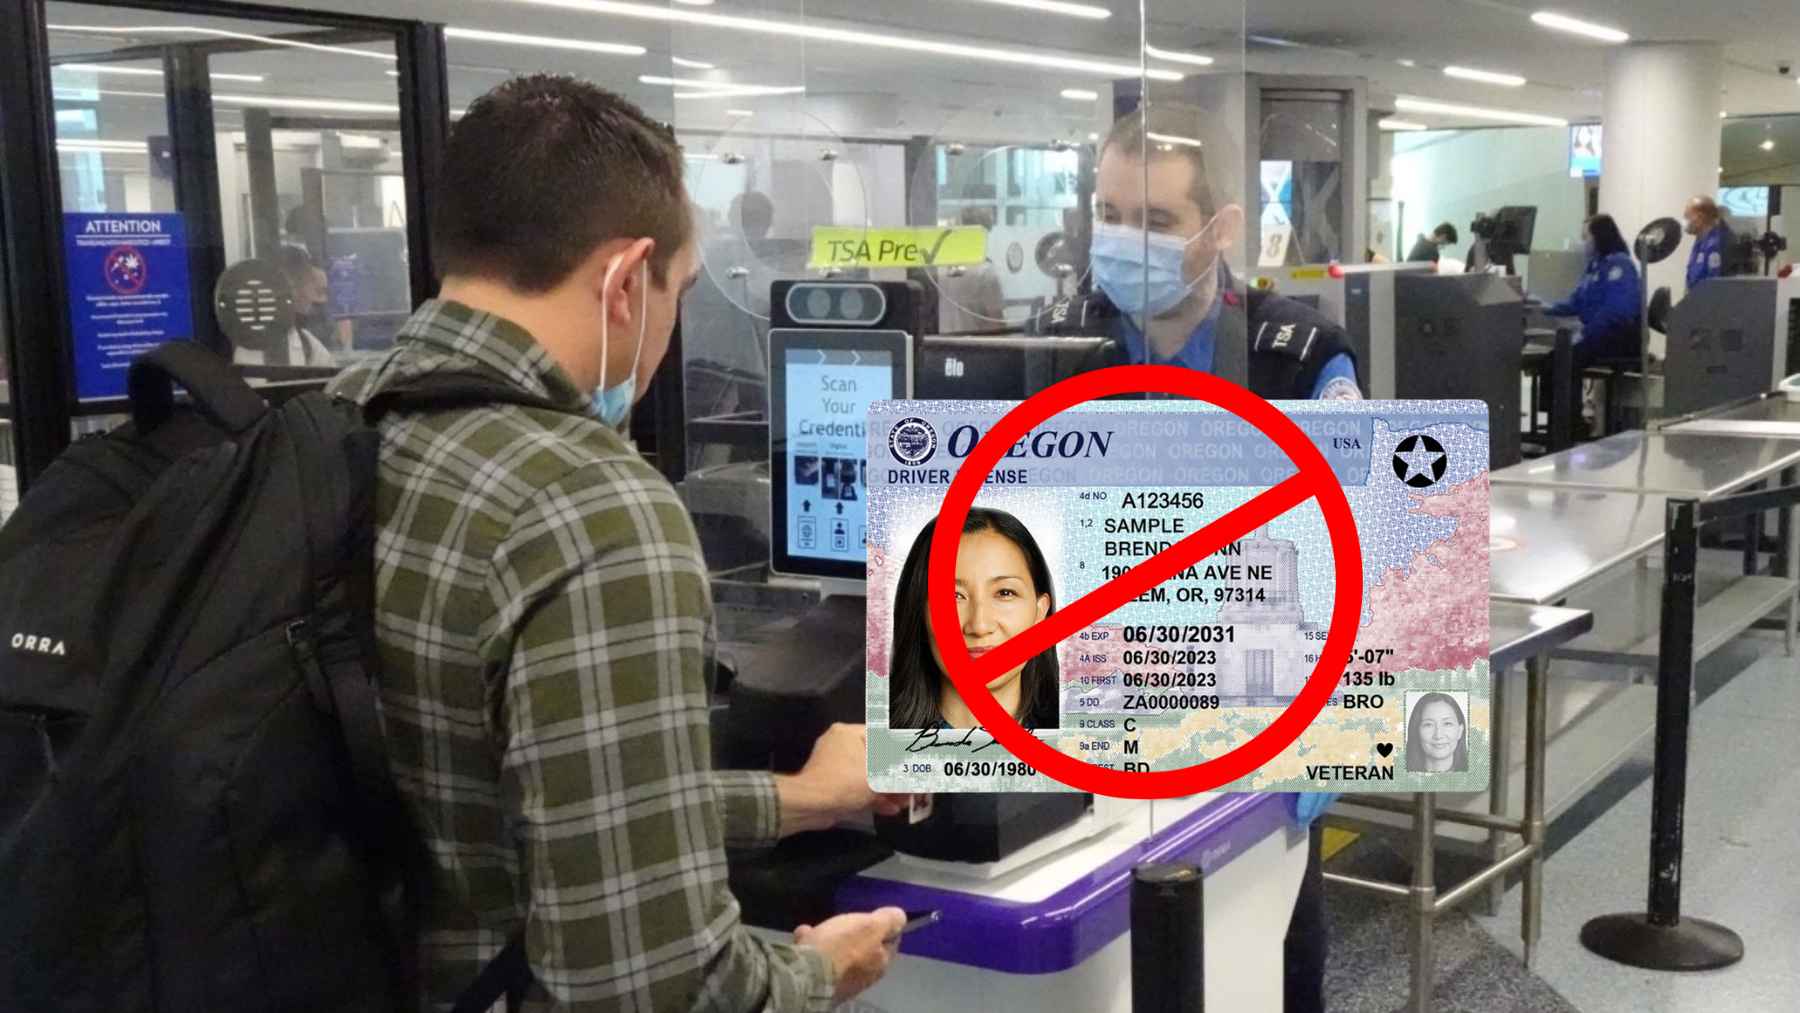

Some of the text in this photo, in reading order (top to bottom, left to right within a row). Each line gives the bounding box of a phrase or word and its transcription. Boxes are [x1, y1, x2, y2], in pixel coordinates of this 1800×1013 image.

[85, 219, 161, 233] ATTENTION
[828, 239, 918, 262] TSA Pre
[1271, 324, 1297, 349] TSA
[821, 375, 857, 392] Scan
[822, 398, 857, 414] Your
[800, 419, 866, 438] Credenti
[11, 632, 66, 656] ORRA
